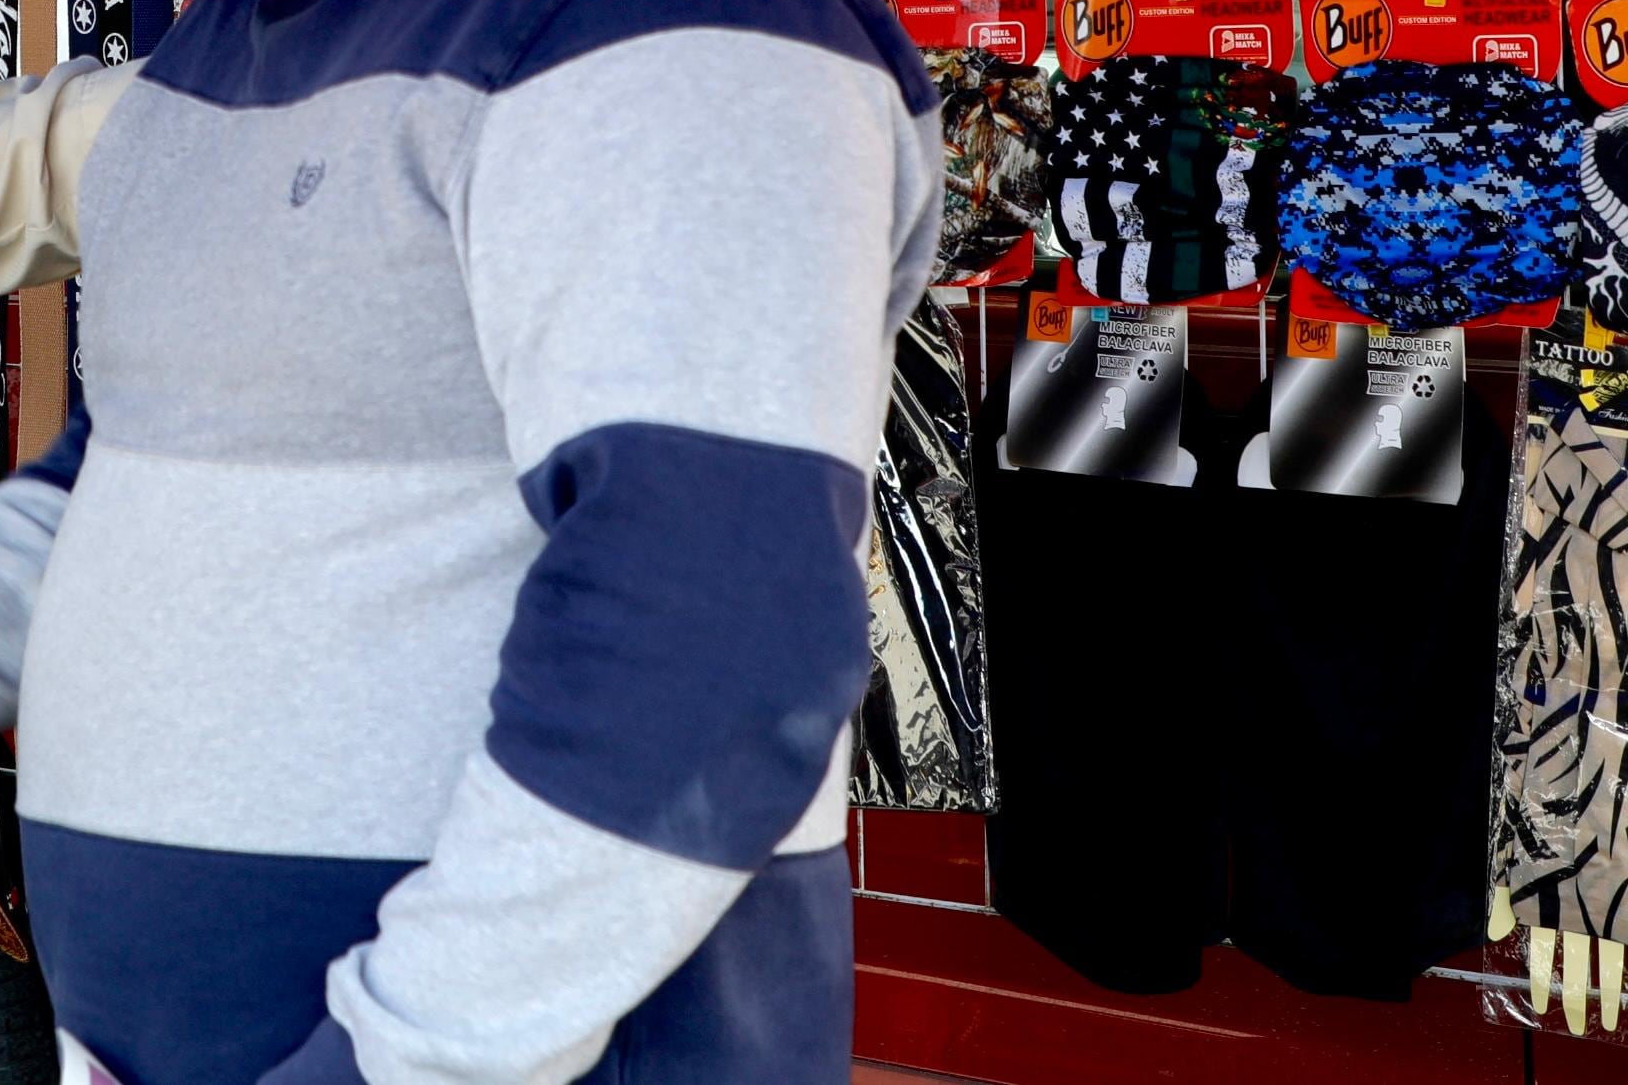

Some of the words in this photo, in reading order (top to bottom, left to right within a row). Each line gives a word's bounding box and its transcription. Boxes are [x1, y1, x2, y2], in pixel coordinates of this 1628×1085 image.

[903, 6, 929, 14] CUSTOM
[930, 5, 955, 14] EDITION
[1139, 8, 1167, 17] CUSTOM
[1169, 6, 1195, 16] EDITION
[1398, 16, 1428, 25] CUSTOM
[1429, 15, 1457, 24] EDITION
[1320, 3, 1383, 56] Buff
[991, 36, 1017, 46] MATCH
[1235, 39, 1263, 49] MATCH
[1499, 49, 1529, 60] MATCH
[1099, 320, 1176, 339] MICROFIBER
[1098, 334, 1174, 354] BALACLAVA
[1368, 335, 1453, 353] MICROFIBER
[1535, 339, 1614, 366] TATTOO
[1368, 351, 1451, 370] BALACLAVA
[1371, 373, 1406, 386] ULTRA
